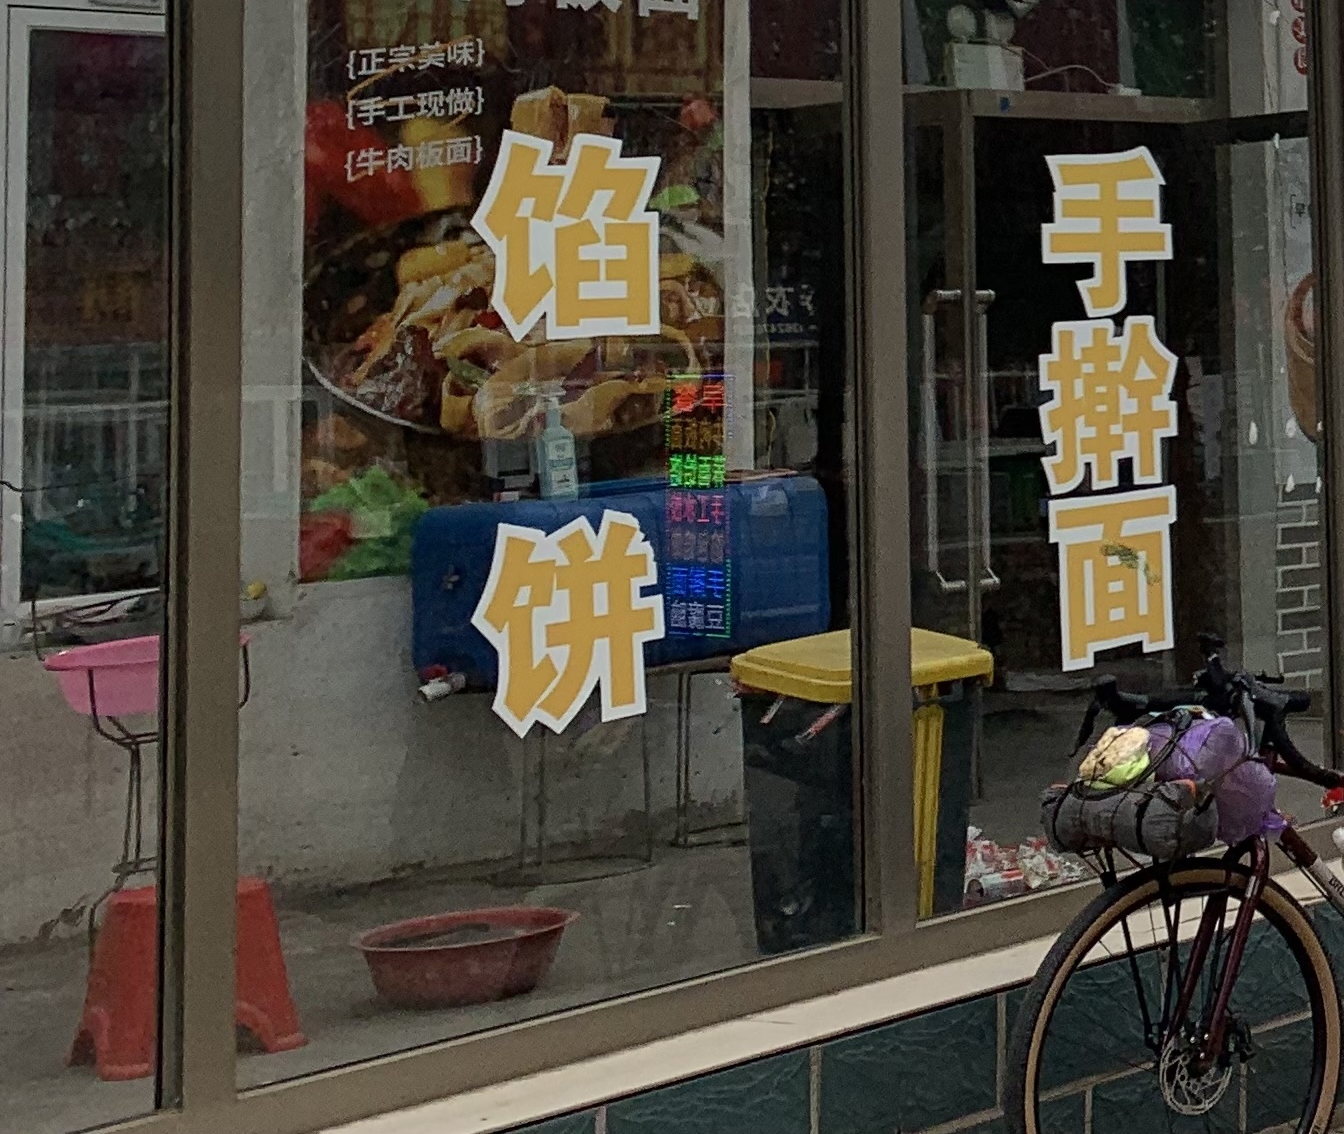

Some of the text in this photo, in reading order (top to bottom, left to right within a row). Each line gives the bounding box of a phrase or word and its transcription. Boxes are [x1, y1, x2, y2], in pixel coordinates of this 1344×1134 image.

[470, 129, 665, 739] 馅饼
[1038, 145, 1179, 672] 手擀面
